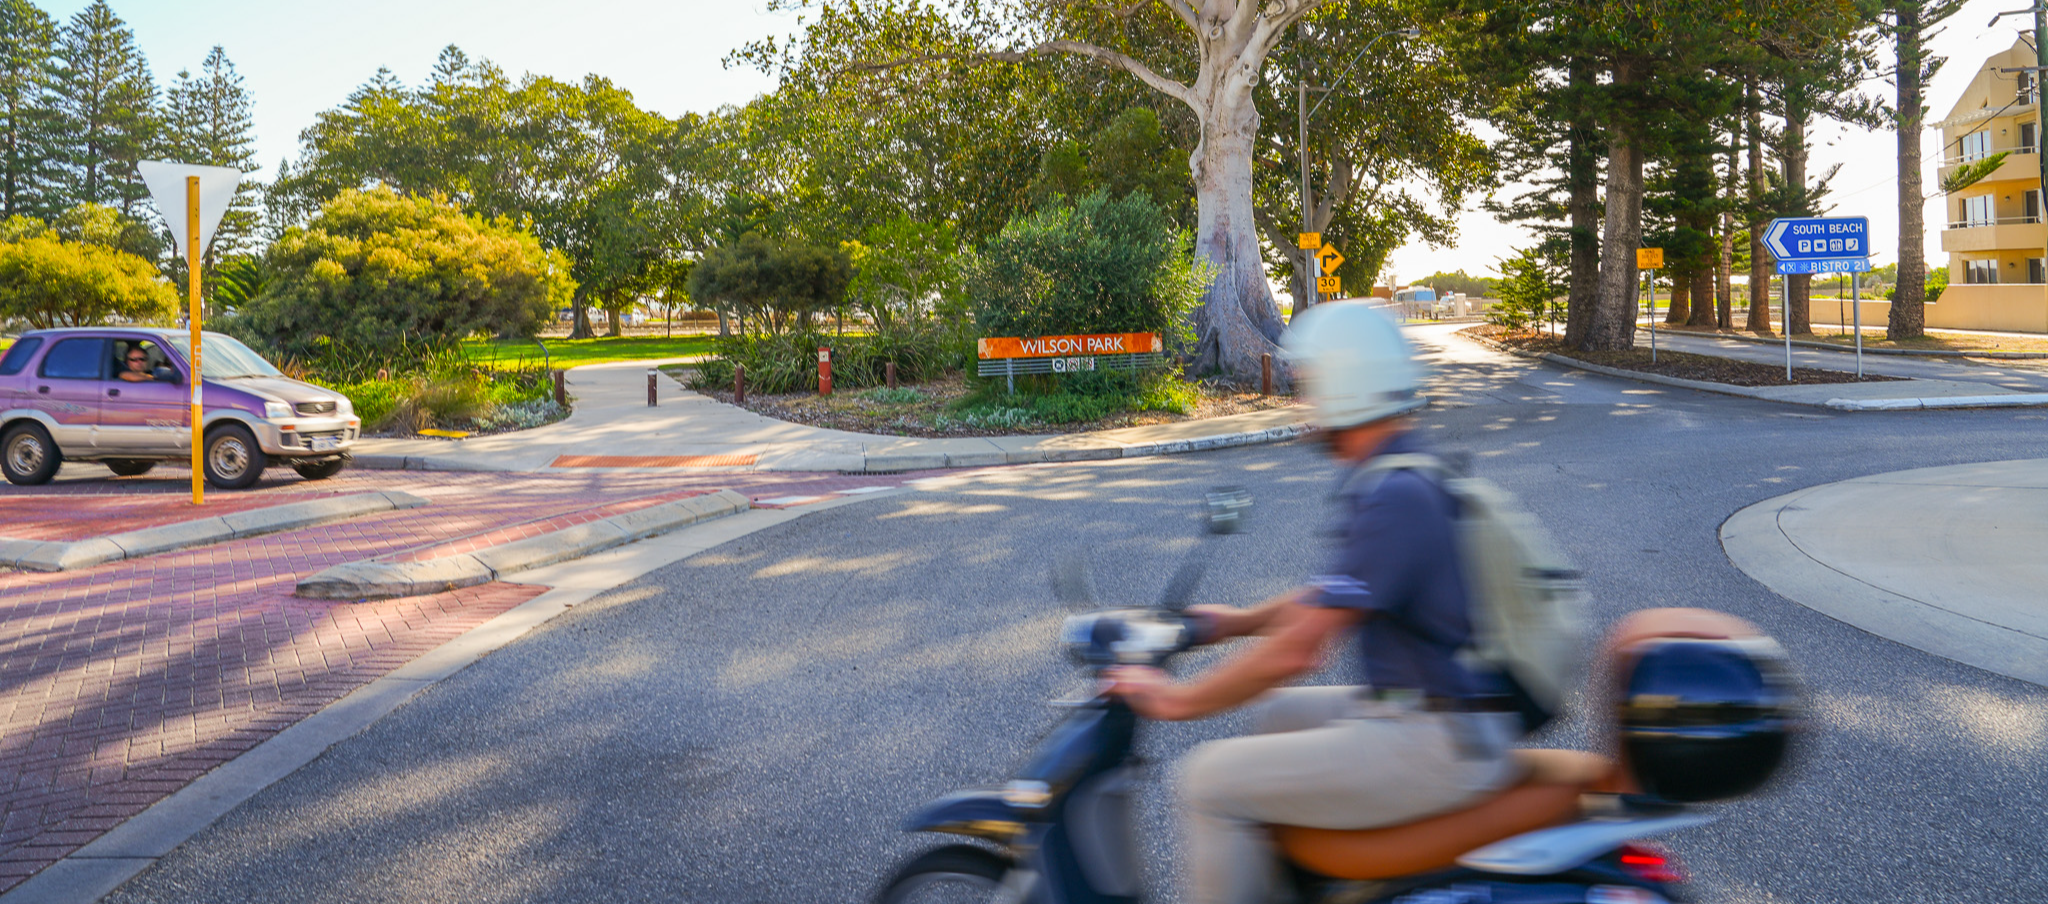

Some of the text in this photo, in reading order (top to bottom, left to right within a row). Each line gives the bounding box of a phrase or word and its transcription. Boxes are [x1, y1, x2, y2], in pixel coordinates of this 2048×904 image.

[1793, 223, 1863, 235] SOUTH BEACH
[1801, 241, 1809, 251] P
[1810, 261, 1866, 272] BISTRO 21
[1321, 278, 1336, 287] 30
[1020, 336, 1124, 354] WILSON PARK
